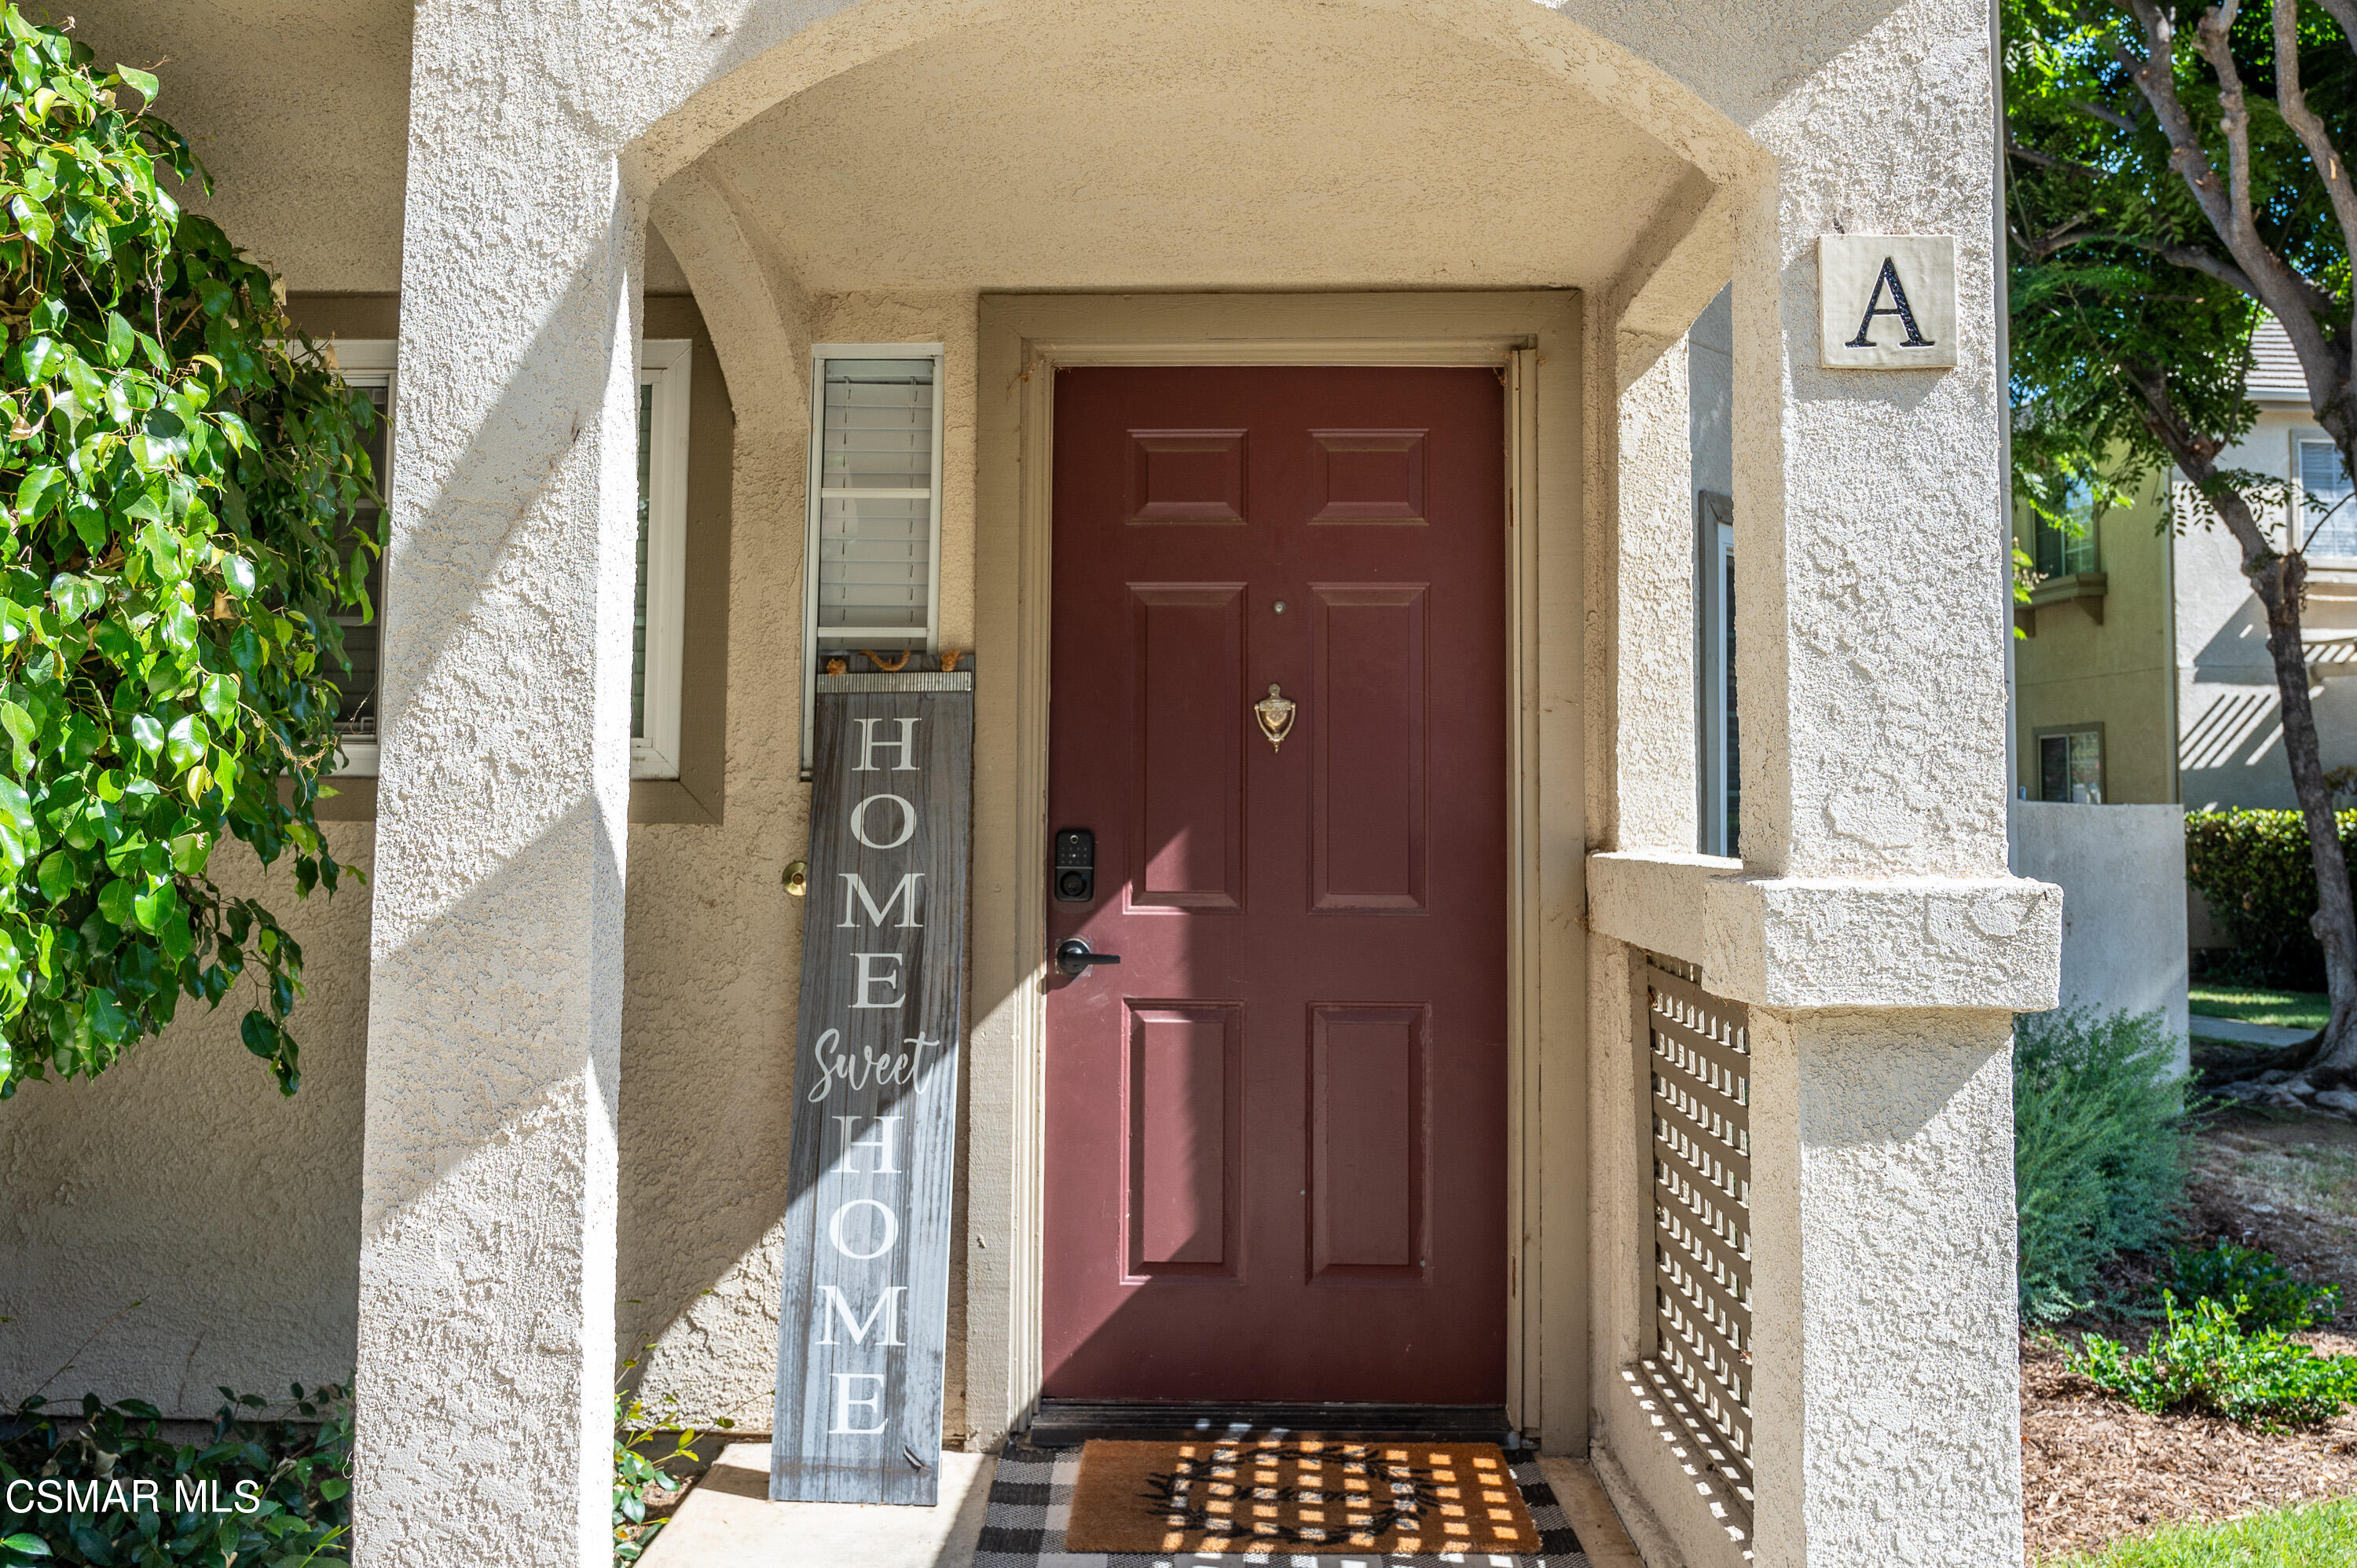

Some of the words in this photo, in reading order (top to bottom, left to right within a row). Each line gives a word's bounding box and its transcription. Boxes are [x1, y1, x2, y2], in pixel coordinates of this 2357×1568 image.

[1845, 256, 1935, 346] A
[837, 717, 926, 1009] HOME
[808, 1028, 940, 1102] Sweet
[815, 1116, 908, 1434] HOME
